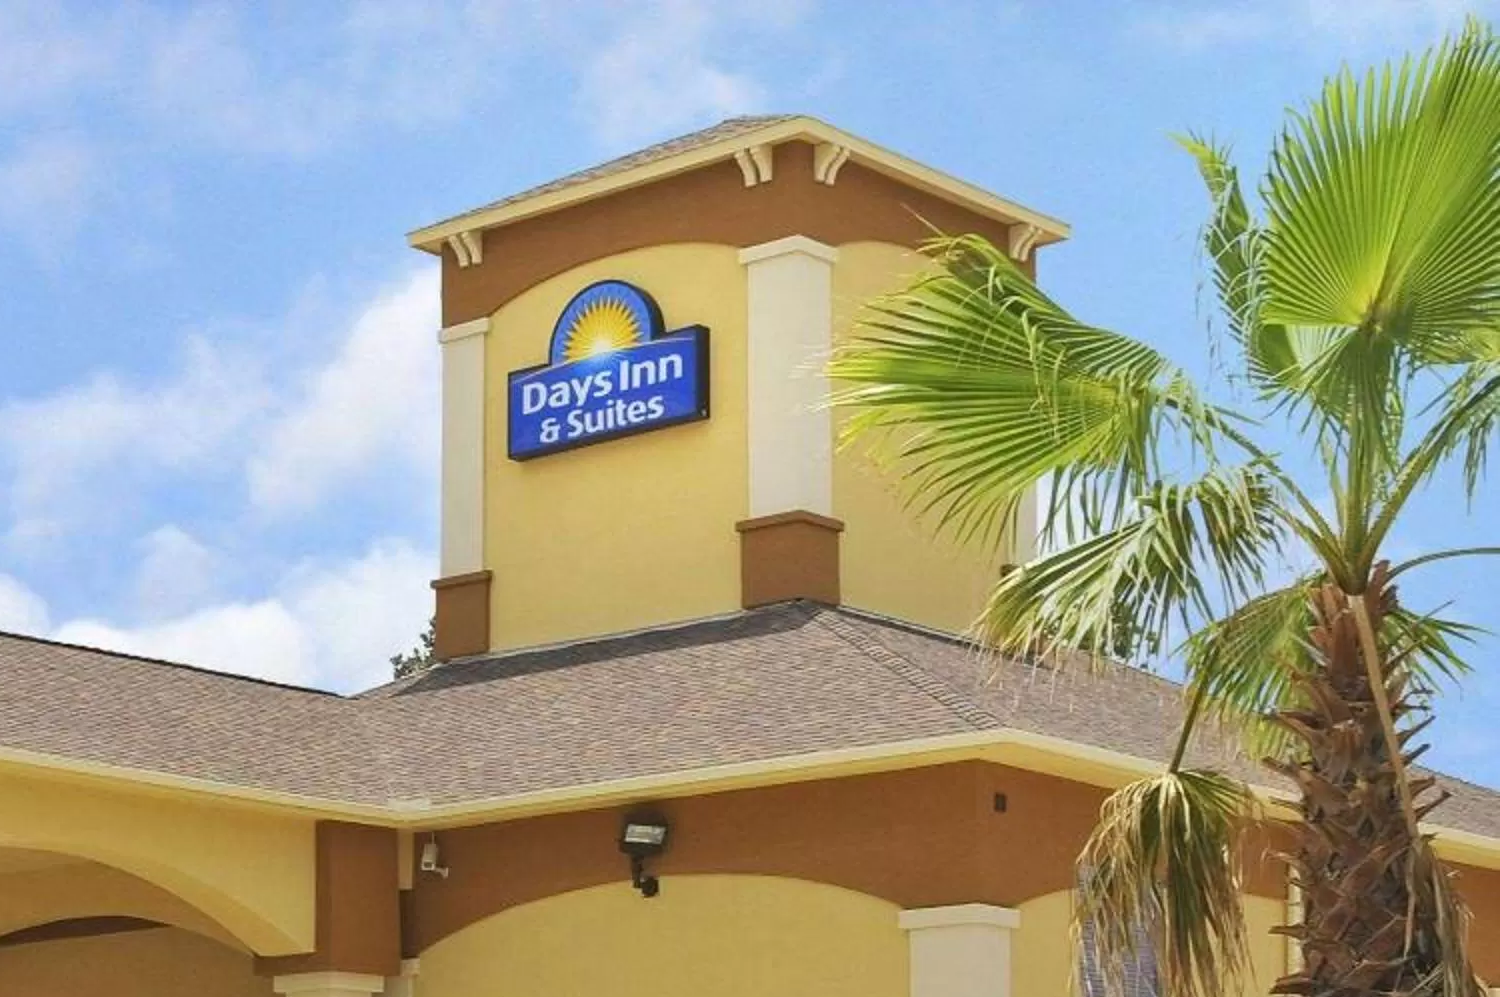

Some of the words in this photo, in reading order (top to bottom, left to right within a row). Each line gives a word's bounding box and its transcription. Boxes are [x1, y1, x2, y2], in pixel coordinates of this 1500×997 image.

[522, 370, 612, 415] Days
[619, 353, 683, 391] Inn
[539, 417, 561, 443] &
[567, 396, 665, 439] Suites
